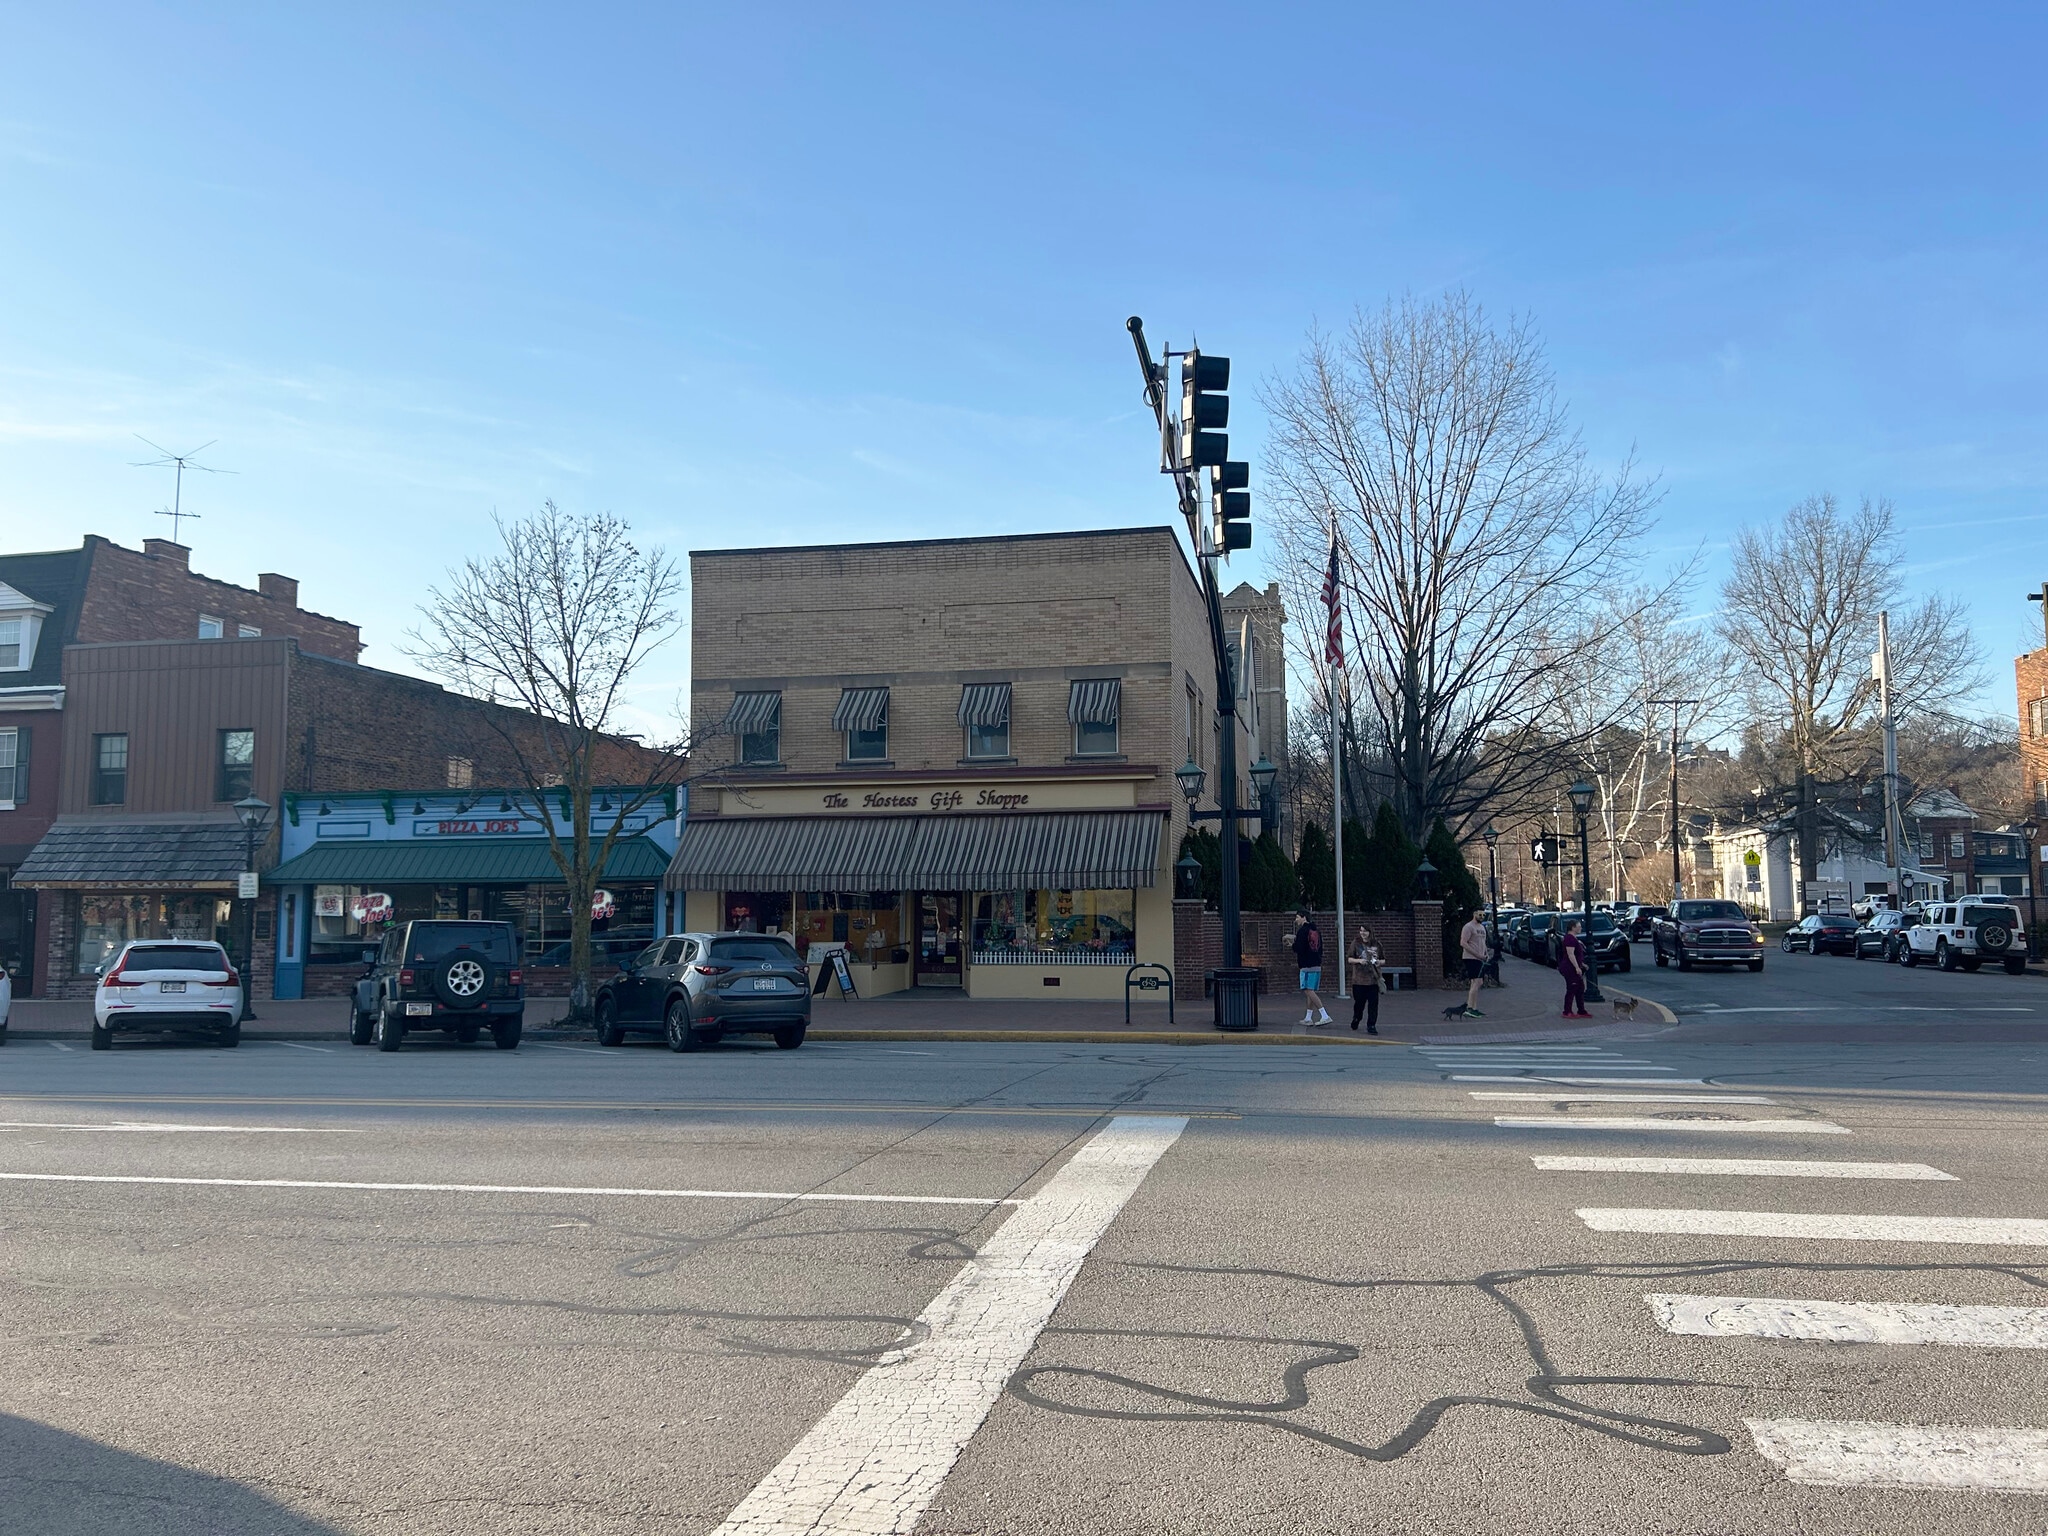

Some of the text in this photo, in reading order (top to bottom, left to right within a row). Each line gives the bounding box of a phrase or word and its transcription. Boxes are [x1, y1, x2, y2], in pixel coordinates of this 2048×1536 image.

[823, 790, 1029, 811] The Hostess Gift Shoppe
[438, 819, 520, 834] PIZZA JOE'S
[1749, 873, 1758, 881] 15
[349, 893, 385, 911] Pizza
[360, 904, 395, 924] Joe's
[591, 902, 616, 921] oe's
